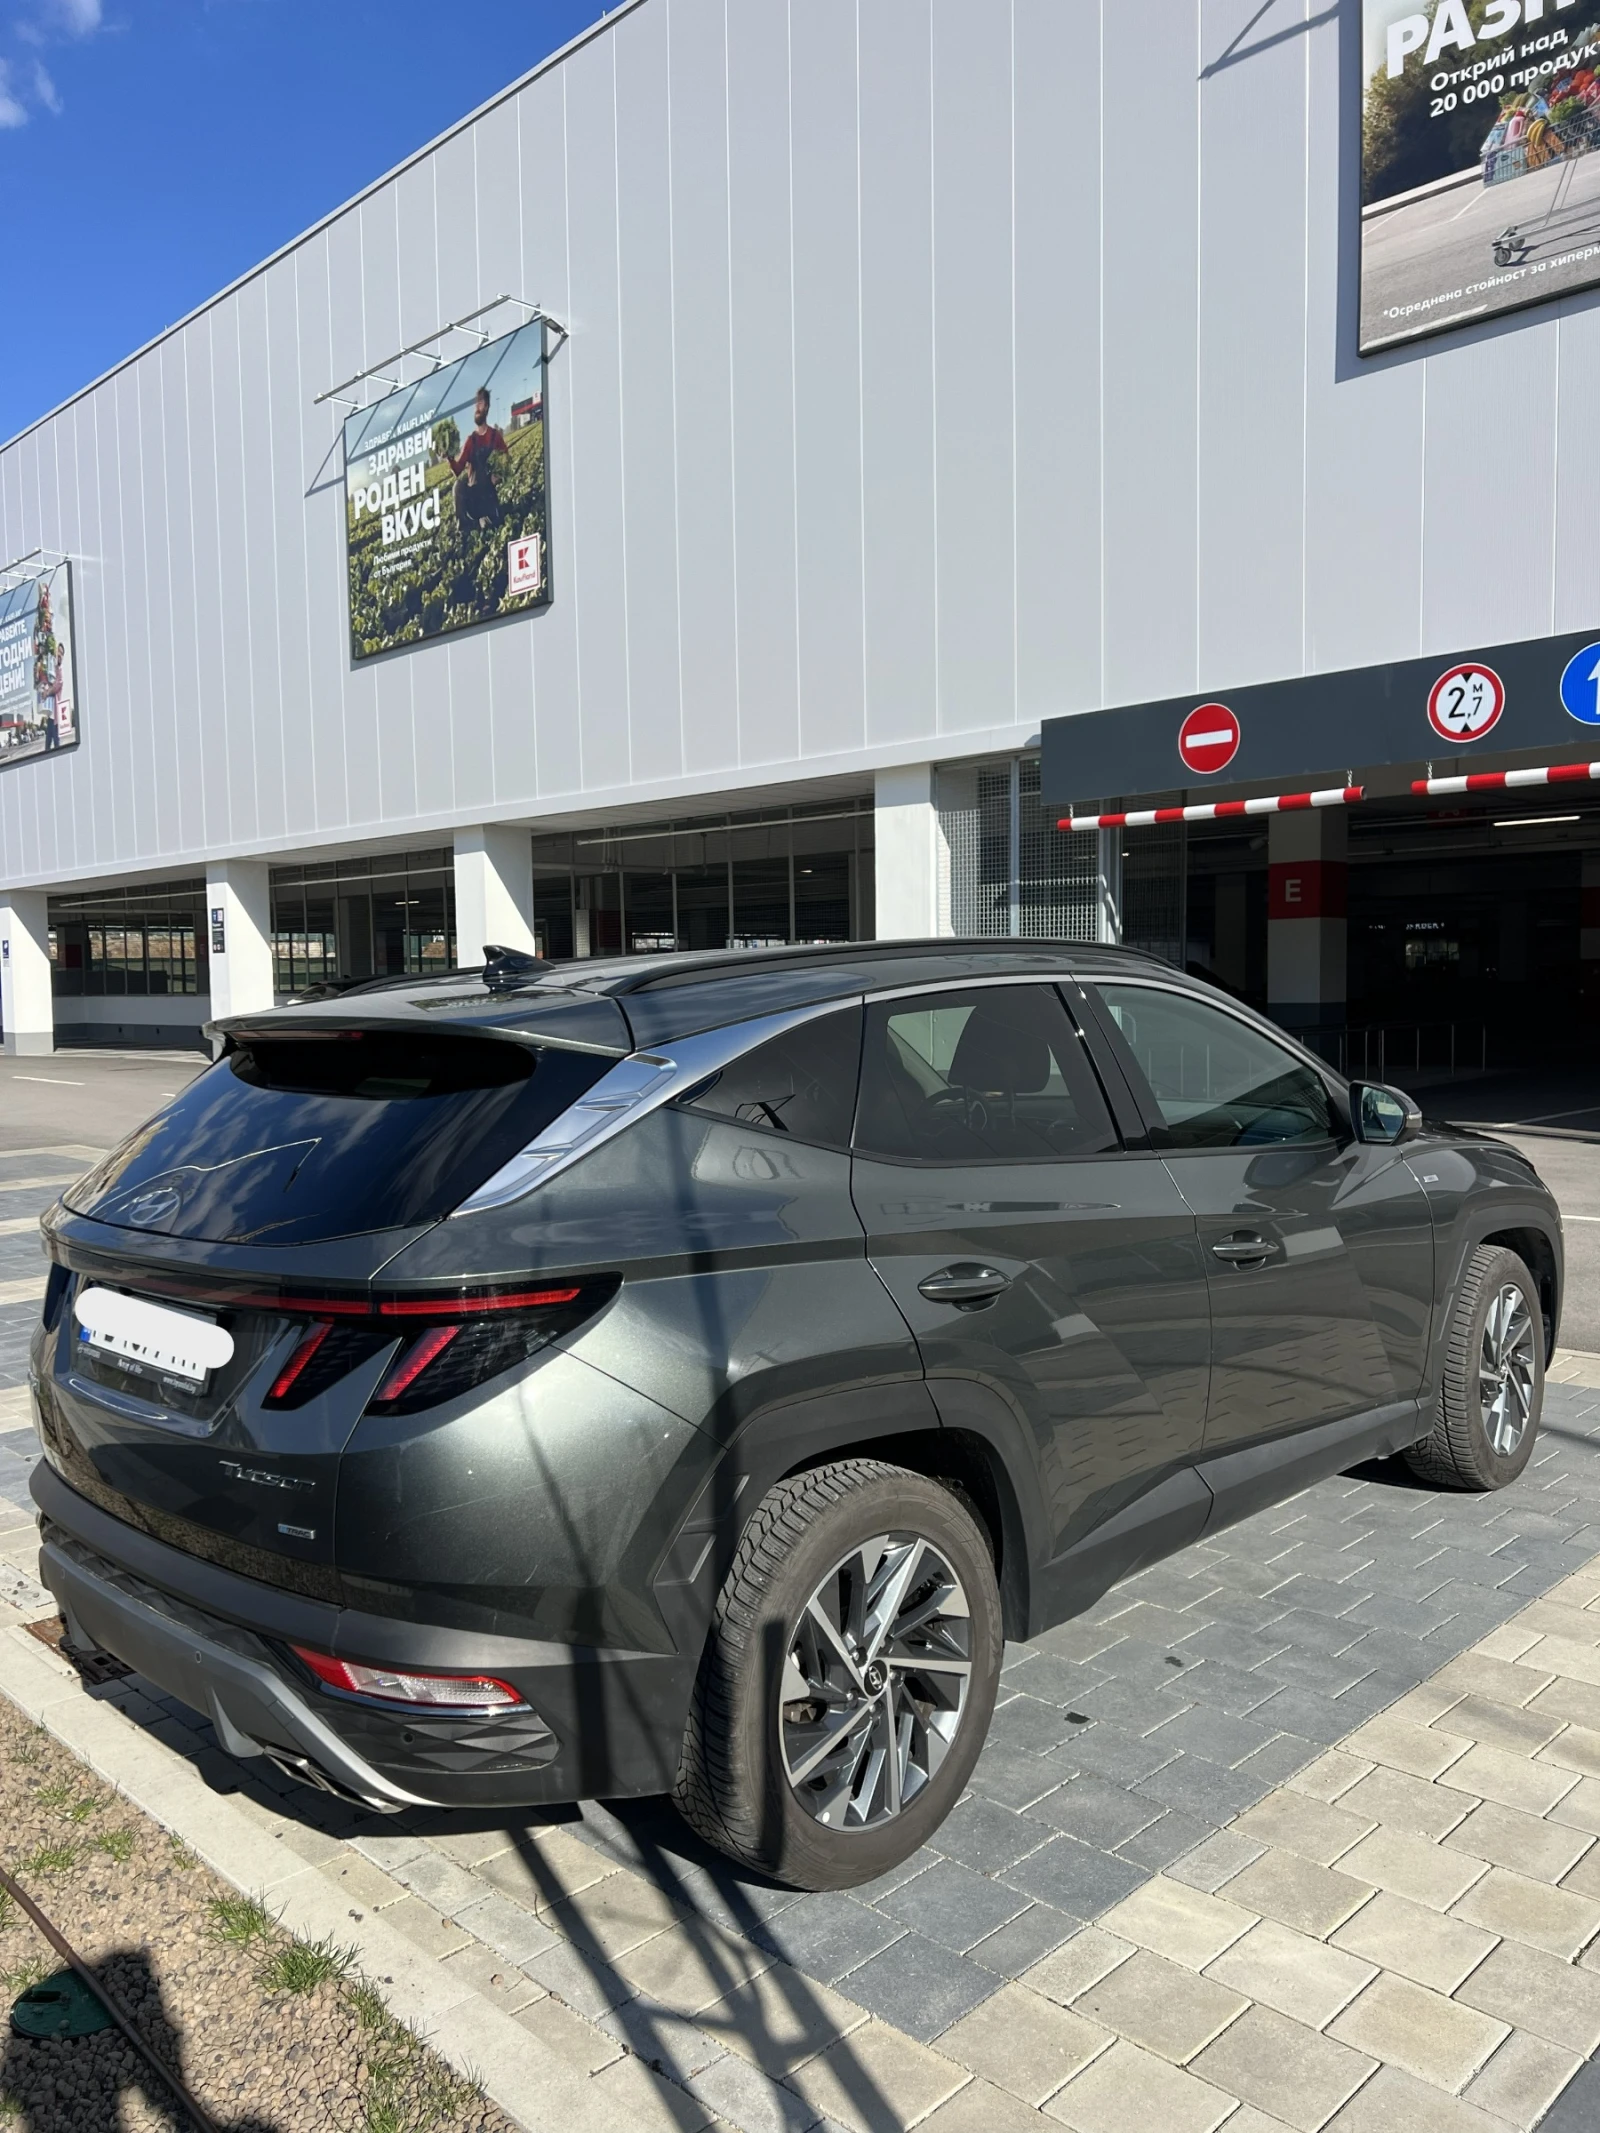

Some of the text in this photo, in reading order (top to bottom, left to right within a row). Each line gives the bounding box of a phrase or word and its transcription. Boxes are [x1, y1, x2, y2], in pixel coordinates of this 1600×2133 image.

[1430, 40, 1600, 117] 20 000 продук
[1431, 28, 1569, 91] Открий над
[1465, 267, 1526, 295] стойност
[1530, 263, 1547, 275] за
[368, 425, 436, 476] ЗДРАВЕЙ,
[353, 460, 426, 520] РОДЕН
[381, 487, 441, 545] ВКУС!
[1285, 879, 1302, 902] E
